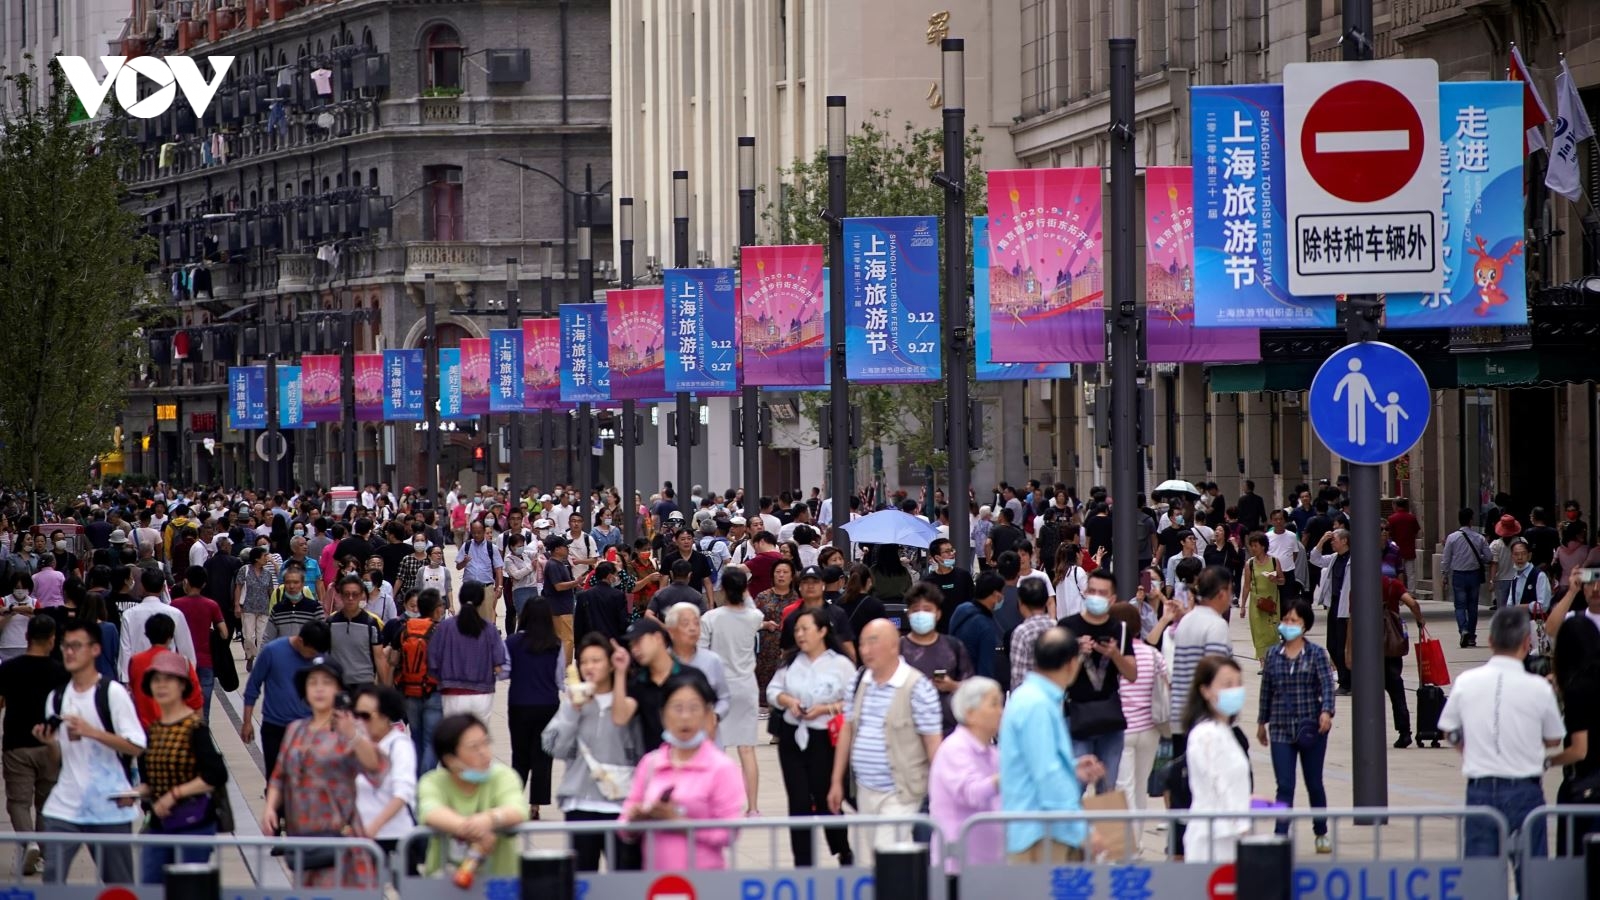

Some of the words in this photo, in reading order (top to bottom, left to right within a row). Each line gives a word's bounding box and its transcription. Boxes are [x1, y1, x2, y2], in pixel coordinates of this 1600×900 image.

[1260, 110, 1271, 171] SHANGHAI
[1455, 105, 1490, 174] 走进
[1221, 110, 1258, 290] 上海旅游节
[1262, 174, 1272, 229] TOURISM
[889, 234, 897, 274] SHANGHAI
[1263, 232, 1273, 289] FESTIVAL
[1302, 223, 1428, 264] 除特种车辆外
[863, 234, 888, 355] 上海旅游节
[890, 278, 898, 315] TOURISM
[907, 312, 935, 323] 9.12
[571, 314, 586, 387] 上海旅游节
[678, 281, 697, 372] 上海旅游节
[711, 340, 732, 349] 9.12
[891, 317, 899, 353] FESTIVAL
[908, 342, 936, 353] 9.27
[391, 356, 402, 409] 上海旅游节
[500, 338, 512, 399] 上海旅游节
[711, 363, 732, 371] 9.27
[1293, 866, 1463, 900] POLICE
